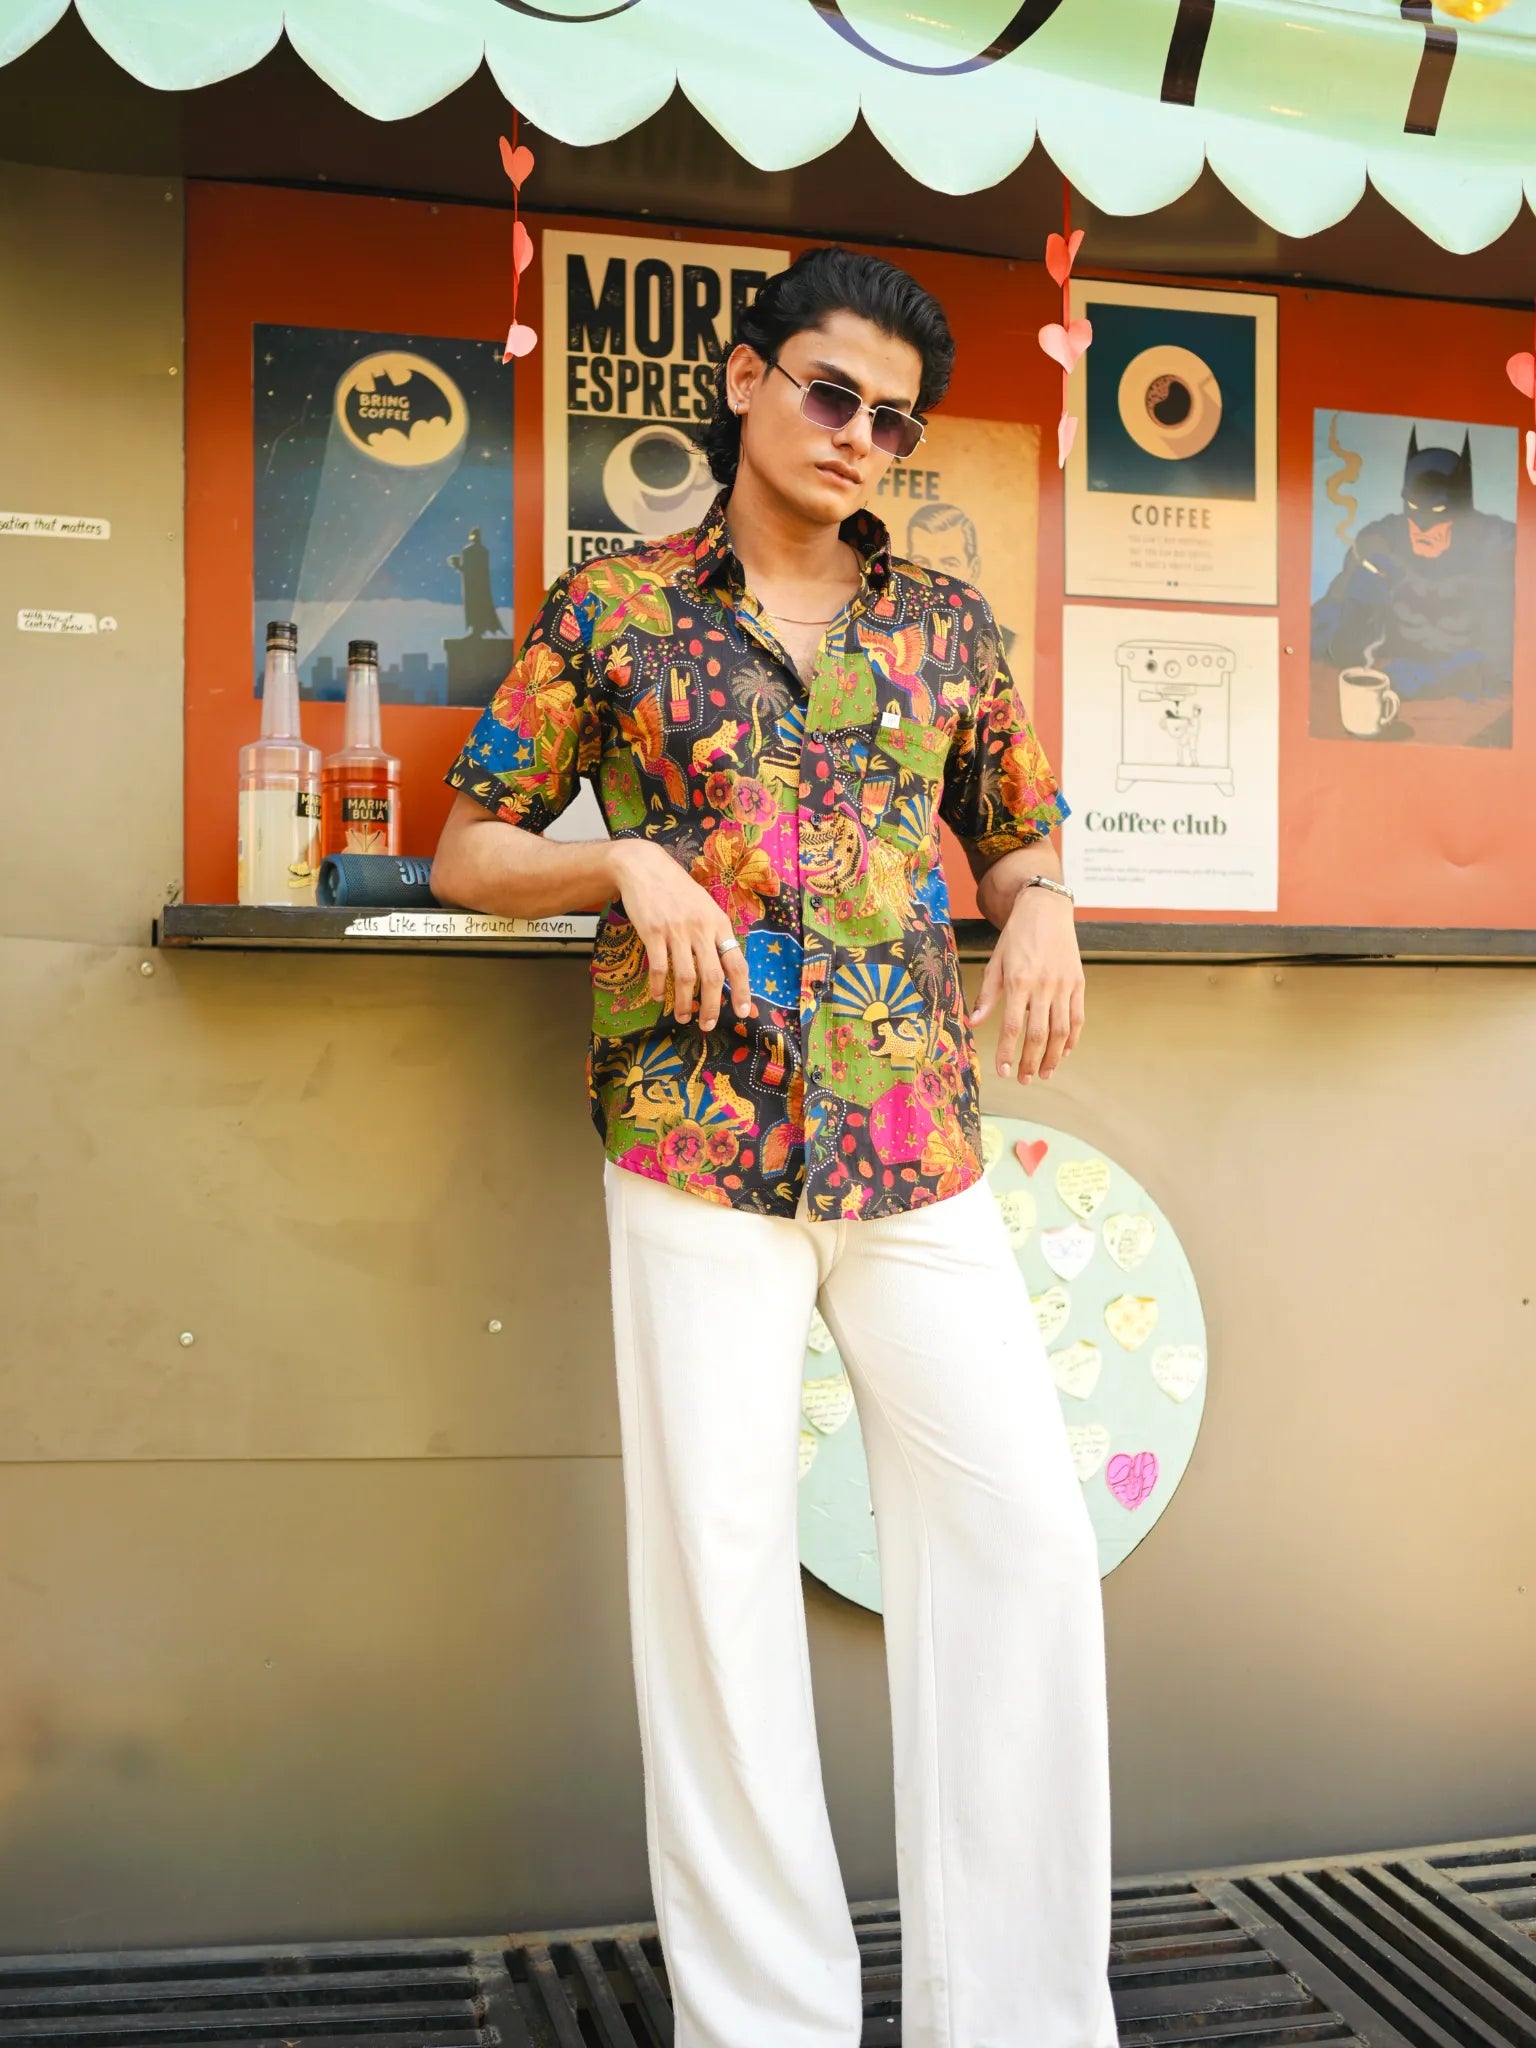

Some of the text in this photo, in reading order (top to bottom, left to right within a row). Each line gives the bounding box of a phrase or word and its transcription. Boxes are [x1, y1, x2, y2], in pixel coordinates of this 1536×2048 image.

[359, 393, 410, 409] BRING
[358, 406, 411, 422] COFFEE
[34, 516, 57, 531] that
[61, 520, 102, 535] matters
[1131, 503, 1212, 530] COFFEE
[352, 809, 385, 821] BULA
[1085, 811, 1228, 836] Coffee club
[424, 915, 456, 935] fresh
[465, 916, 514, 934] ground
